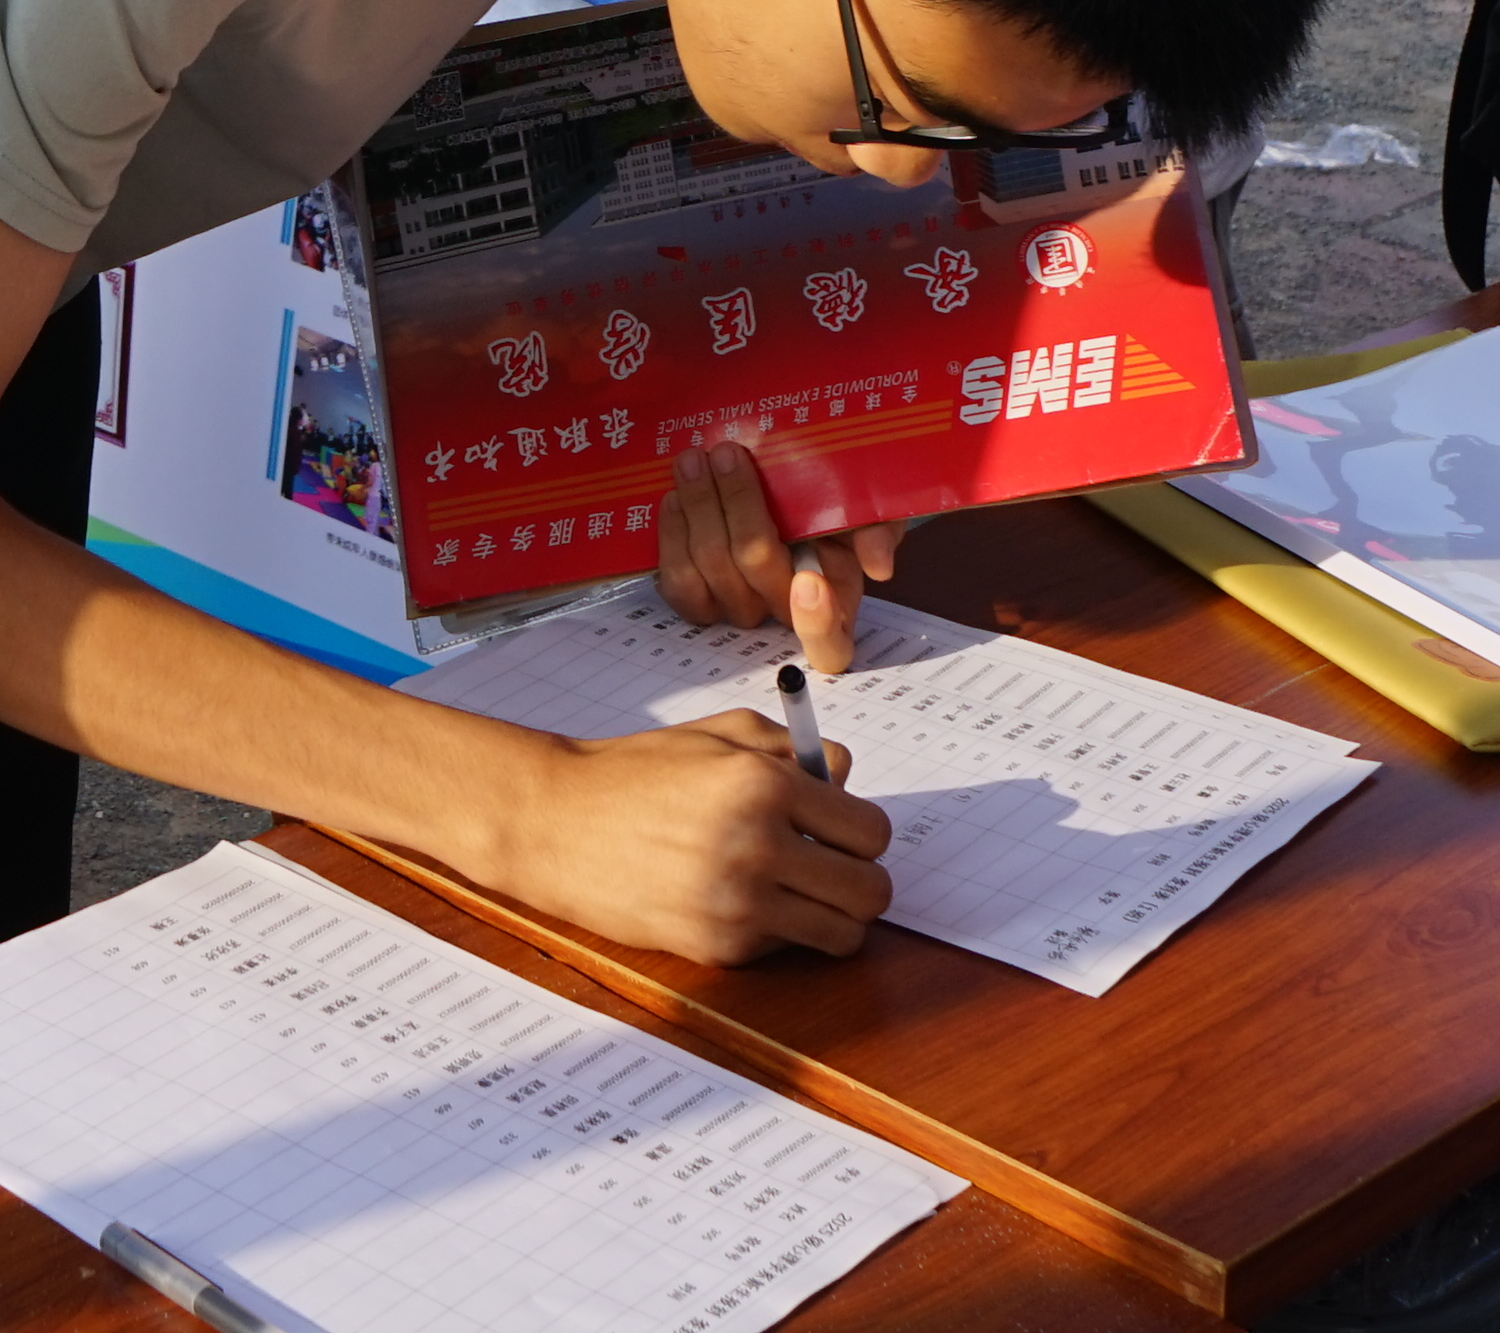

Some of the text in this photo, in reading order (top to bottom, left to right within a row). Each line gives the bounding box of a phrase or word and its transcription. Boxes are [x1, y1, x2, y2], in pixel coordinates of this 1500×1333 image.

[487, 245, 977, 398] 承德医学院
[656, 367, 919, 434] WORLDWIDE EXPRESS MAIL SERVICE
[961, 337, 1127, 424] EMS
[425, 407, 635, 482] 录取通知书
[653, 382, 919, 455] 全球邮政特快专递
[435, 503, 653, 565] 速递服务专家
[818, 1213, 852, 1236] 2025
